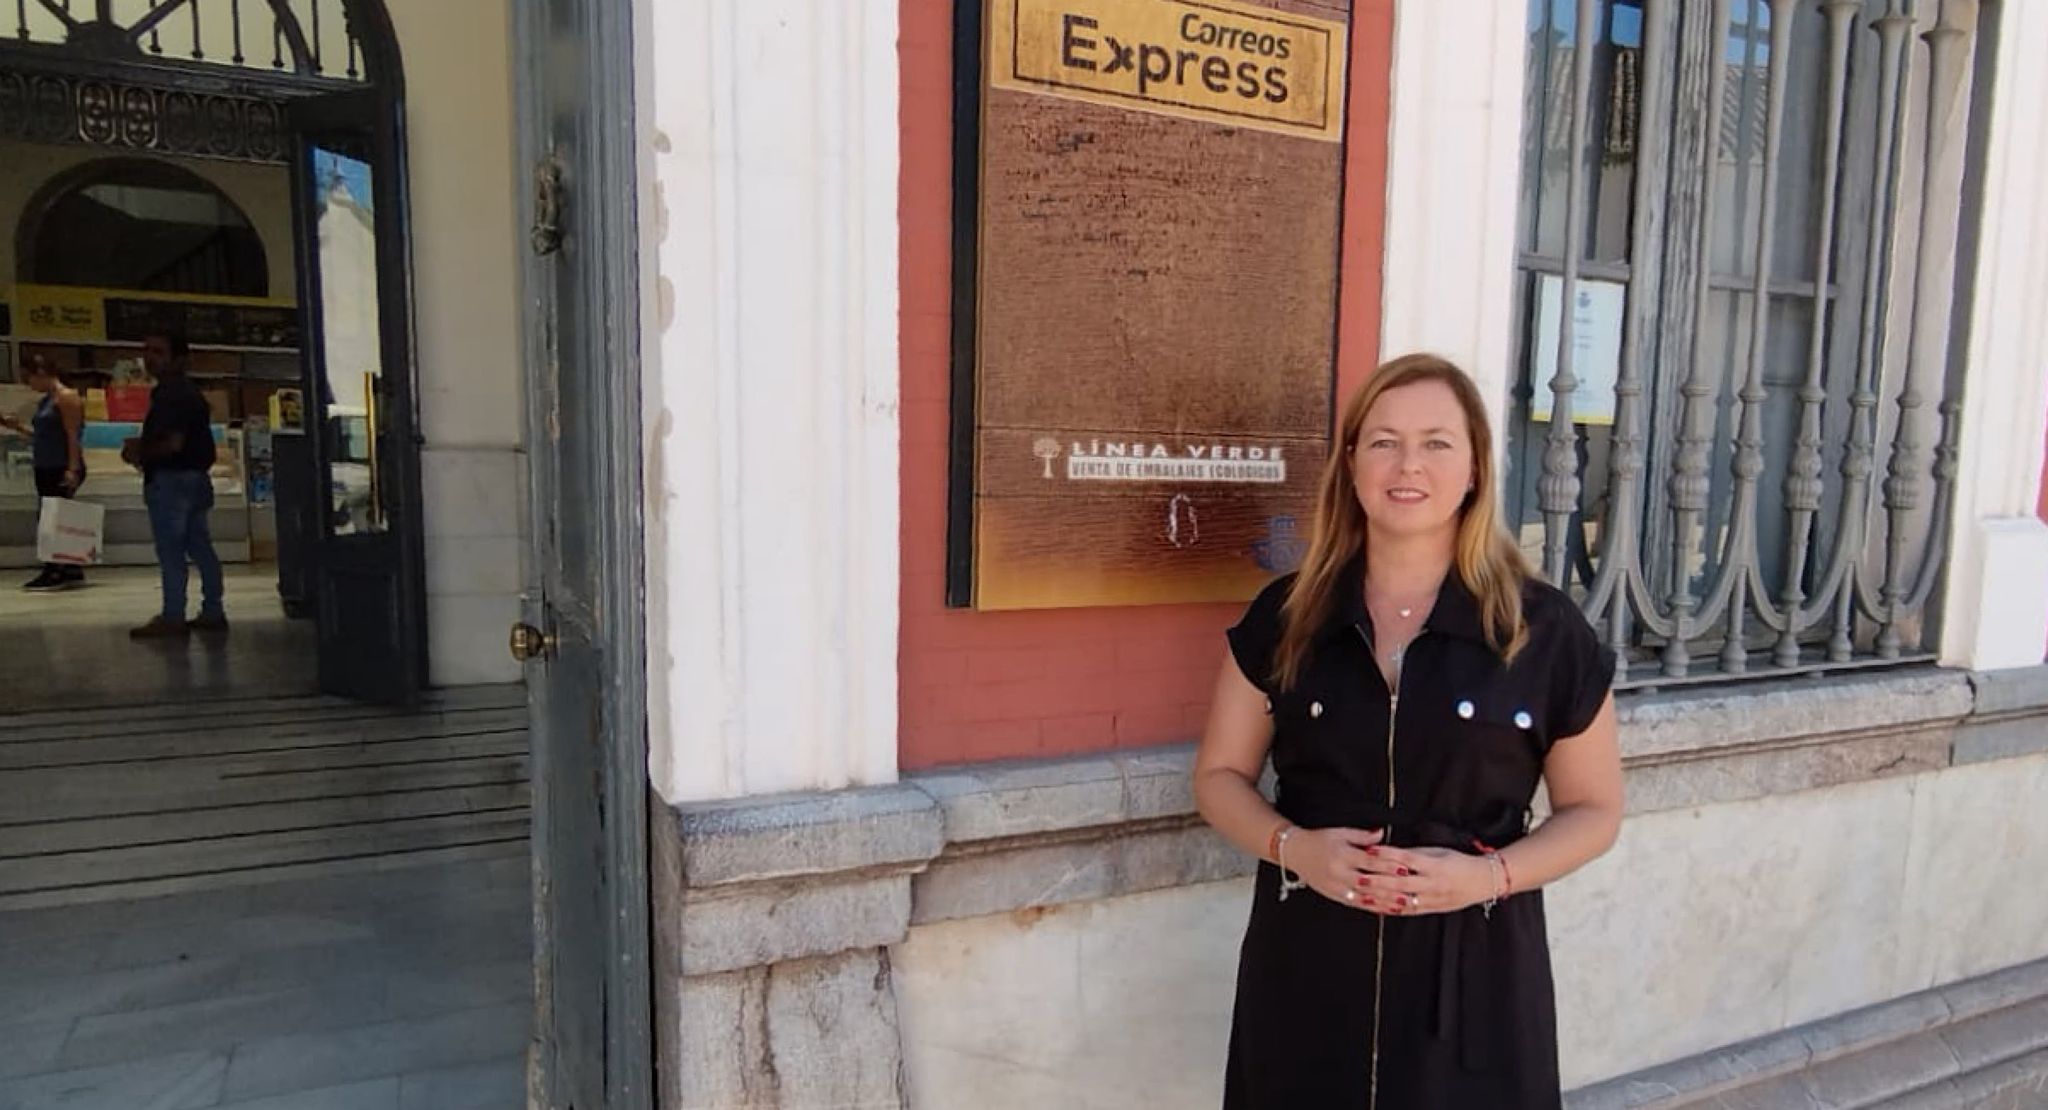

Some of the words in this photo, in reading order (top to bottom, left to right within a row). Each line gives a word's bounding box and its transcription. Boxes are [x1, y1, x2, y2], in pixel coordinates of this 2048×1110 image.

[1180, 12, 1291, 61] Correos
[1062, 13, 1289, 103] Express
[1187, 444, 1282, 460] VERDE
[1072, 462, 1110, 477] VENTA
[1116, 463, 1133, 477] DE
[1136, 463, 1204, 478] EMBALAJES
